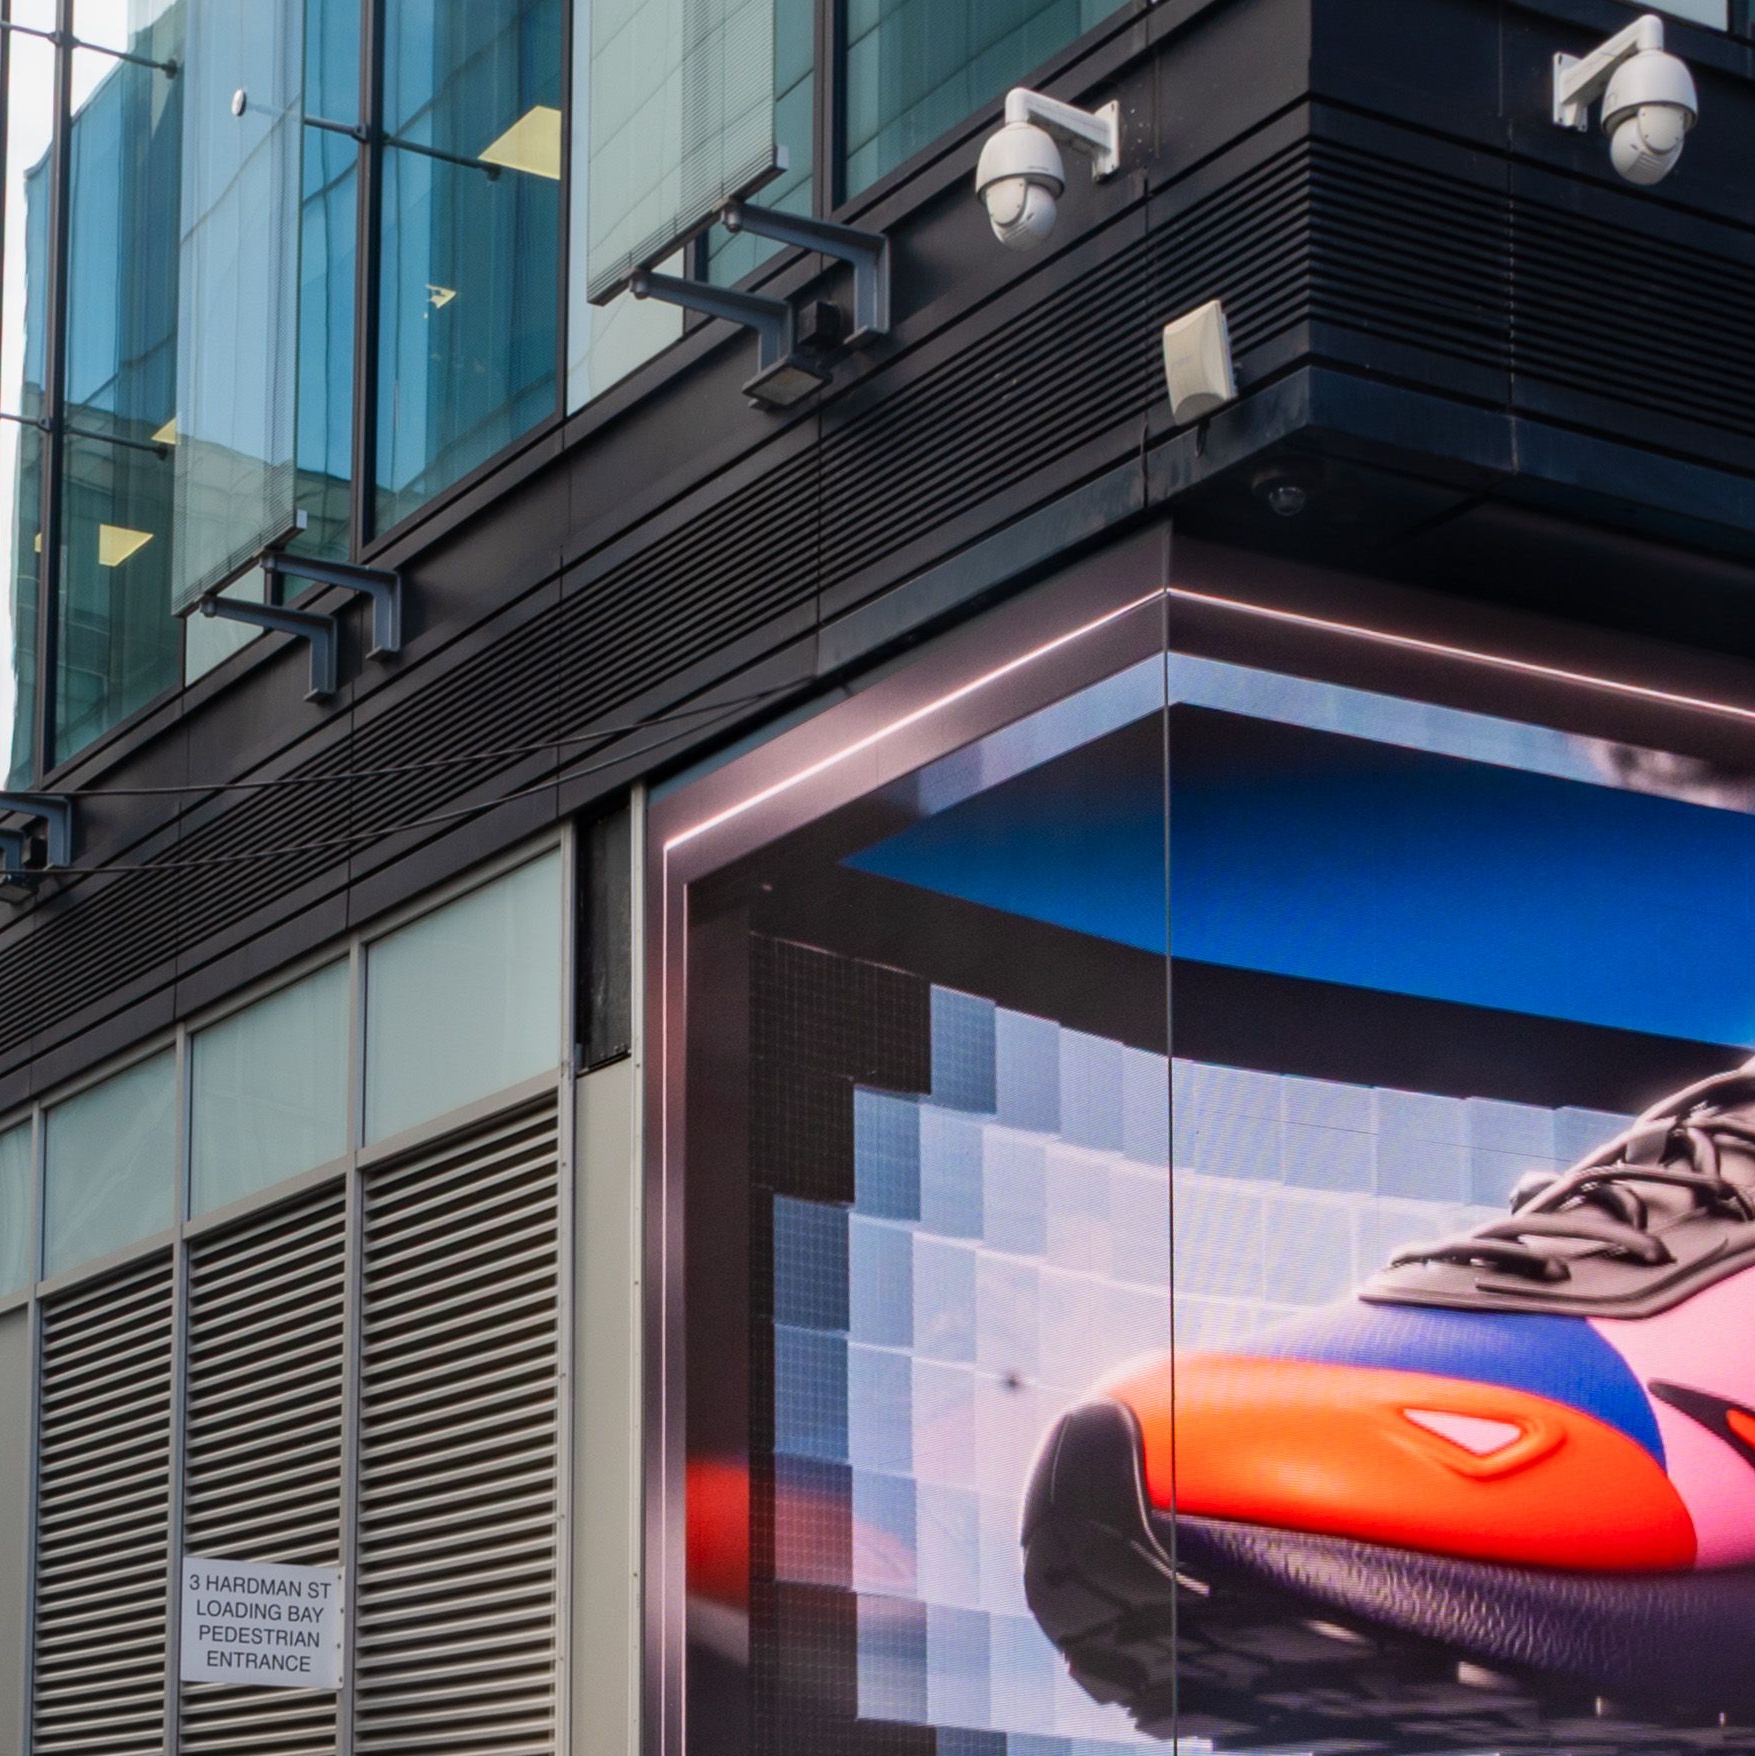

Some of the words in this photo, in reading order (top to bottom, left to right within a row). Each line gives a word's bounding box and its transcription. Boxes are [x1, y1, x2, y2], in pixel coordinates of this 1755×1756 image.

[189, 1574, 200, 1590] 3
[206, 1575, 301, 1597] HARDMAN
[307, 1582, 332, 1599] ST
[197, 1599, 281, 1621] LOADING
[288, 1605, 324, 1623] BAY
[199, 1625, 320, 1648] PEDESTRIAN
[207, 1650, 311, 1672] ENTRANCE
